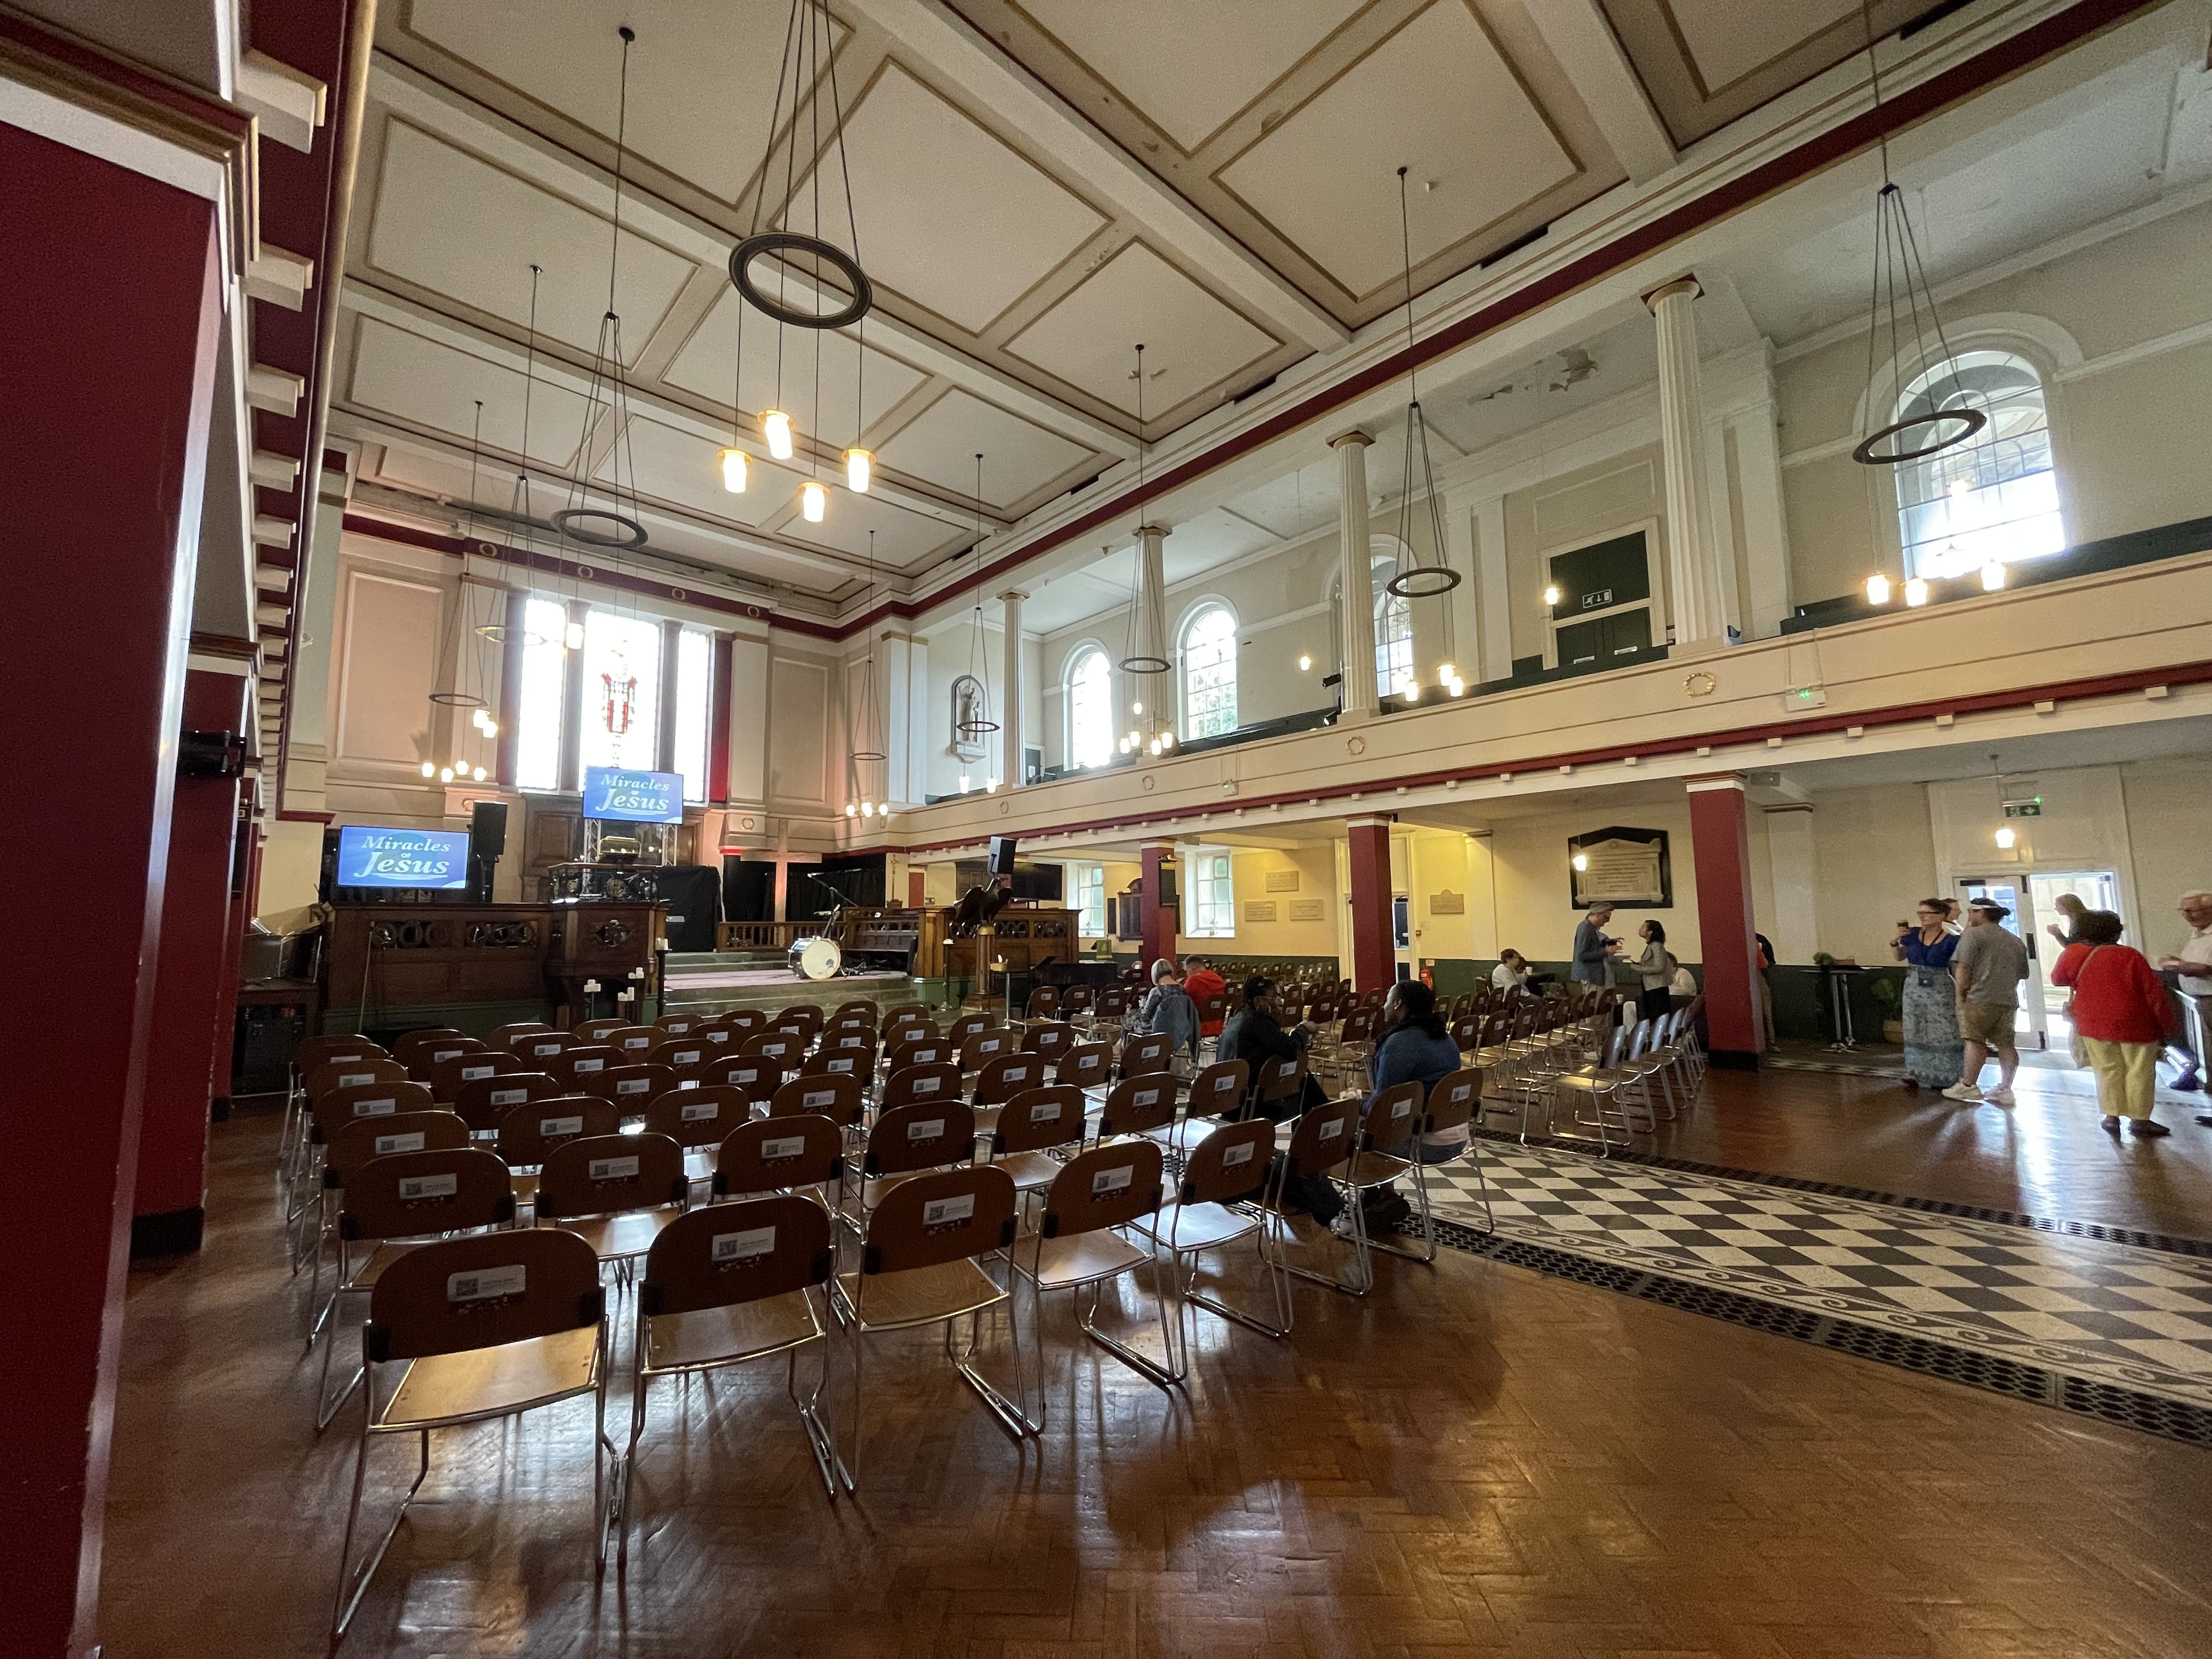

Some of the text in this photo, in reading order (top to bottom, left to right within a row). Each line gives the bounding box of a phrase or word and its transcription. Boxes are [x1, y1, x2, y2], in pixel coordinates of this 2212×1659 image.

[601, 774, 670, 791] Miracles
[595, 789, 669, 811] Jesus
[361, 836, 452, 851] Miracles
[353, 851, 450, 878] Jesus
